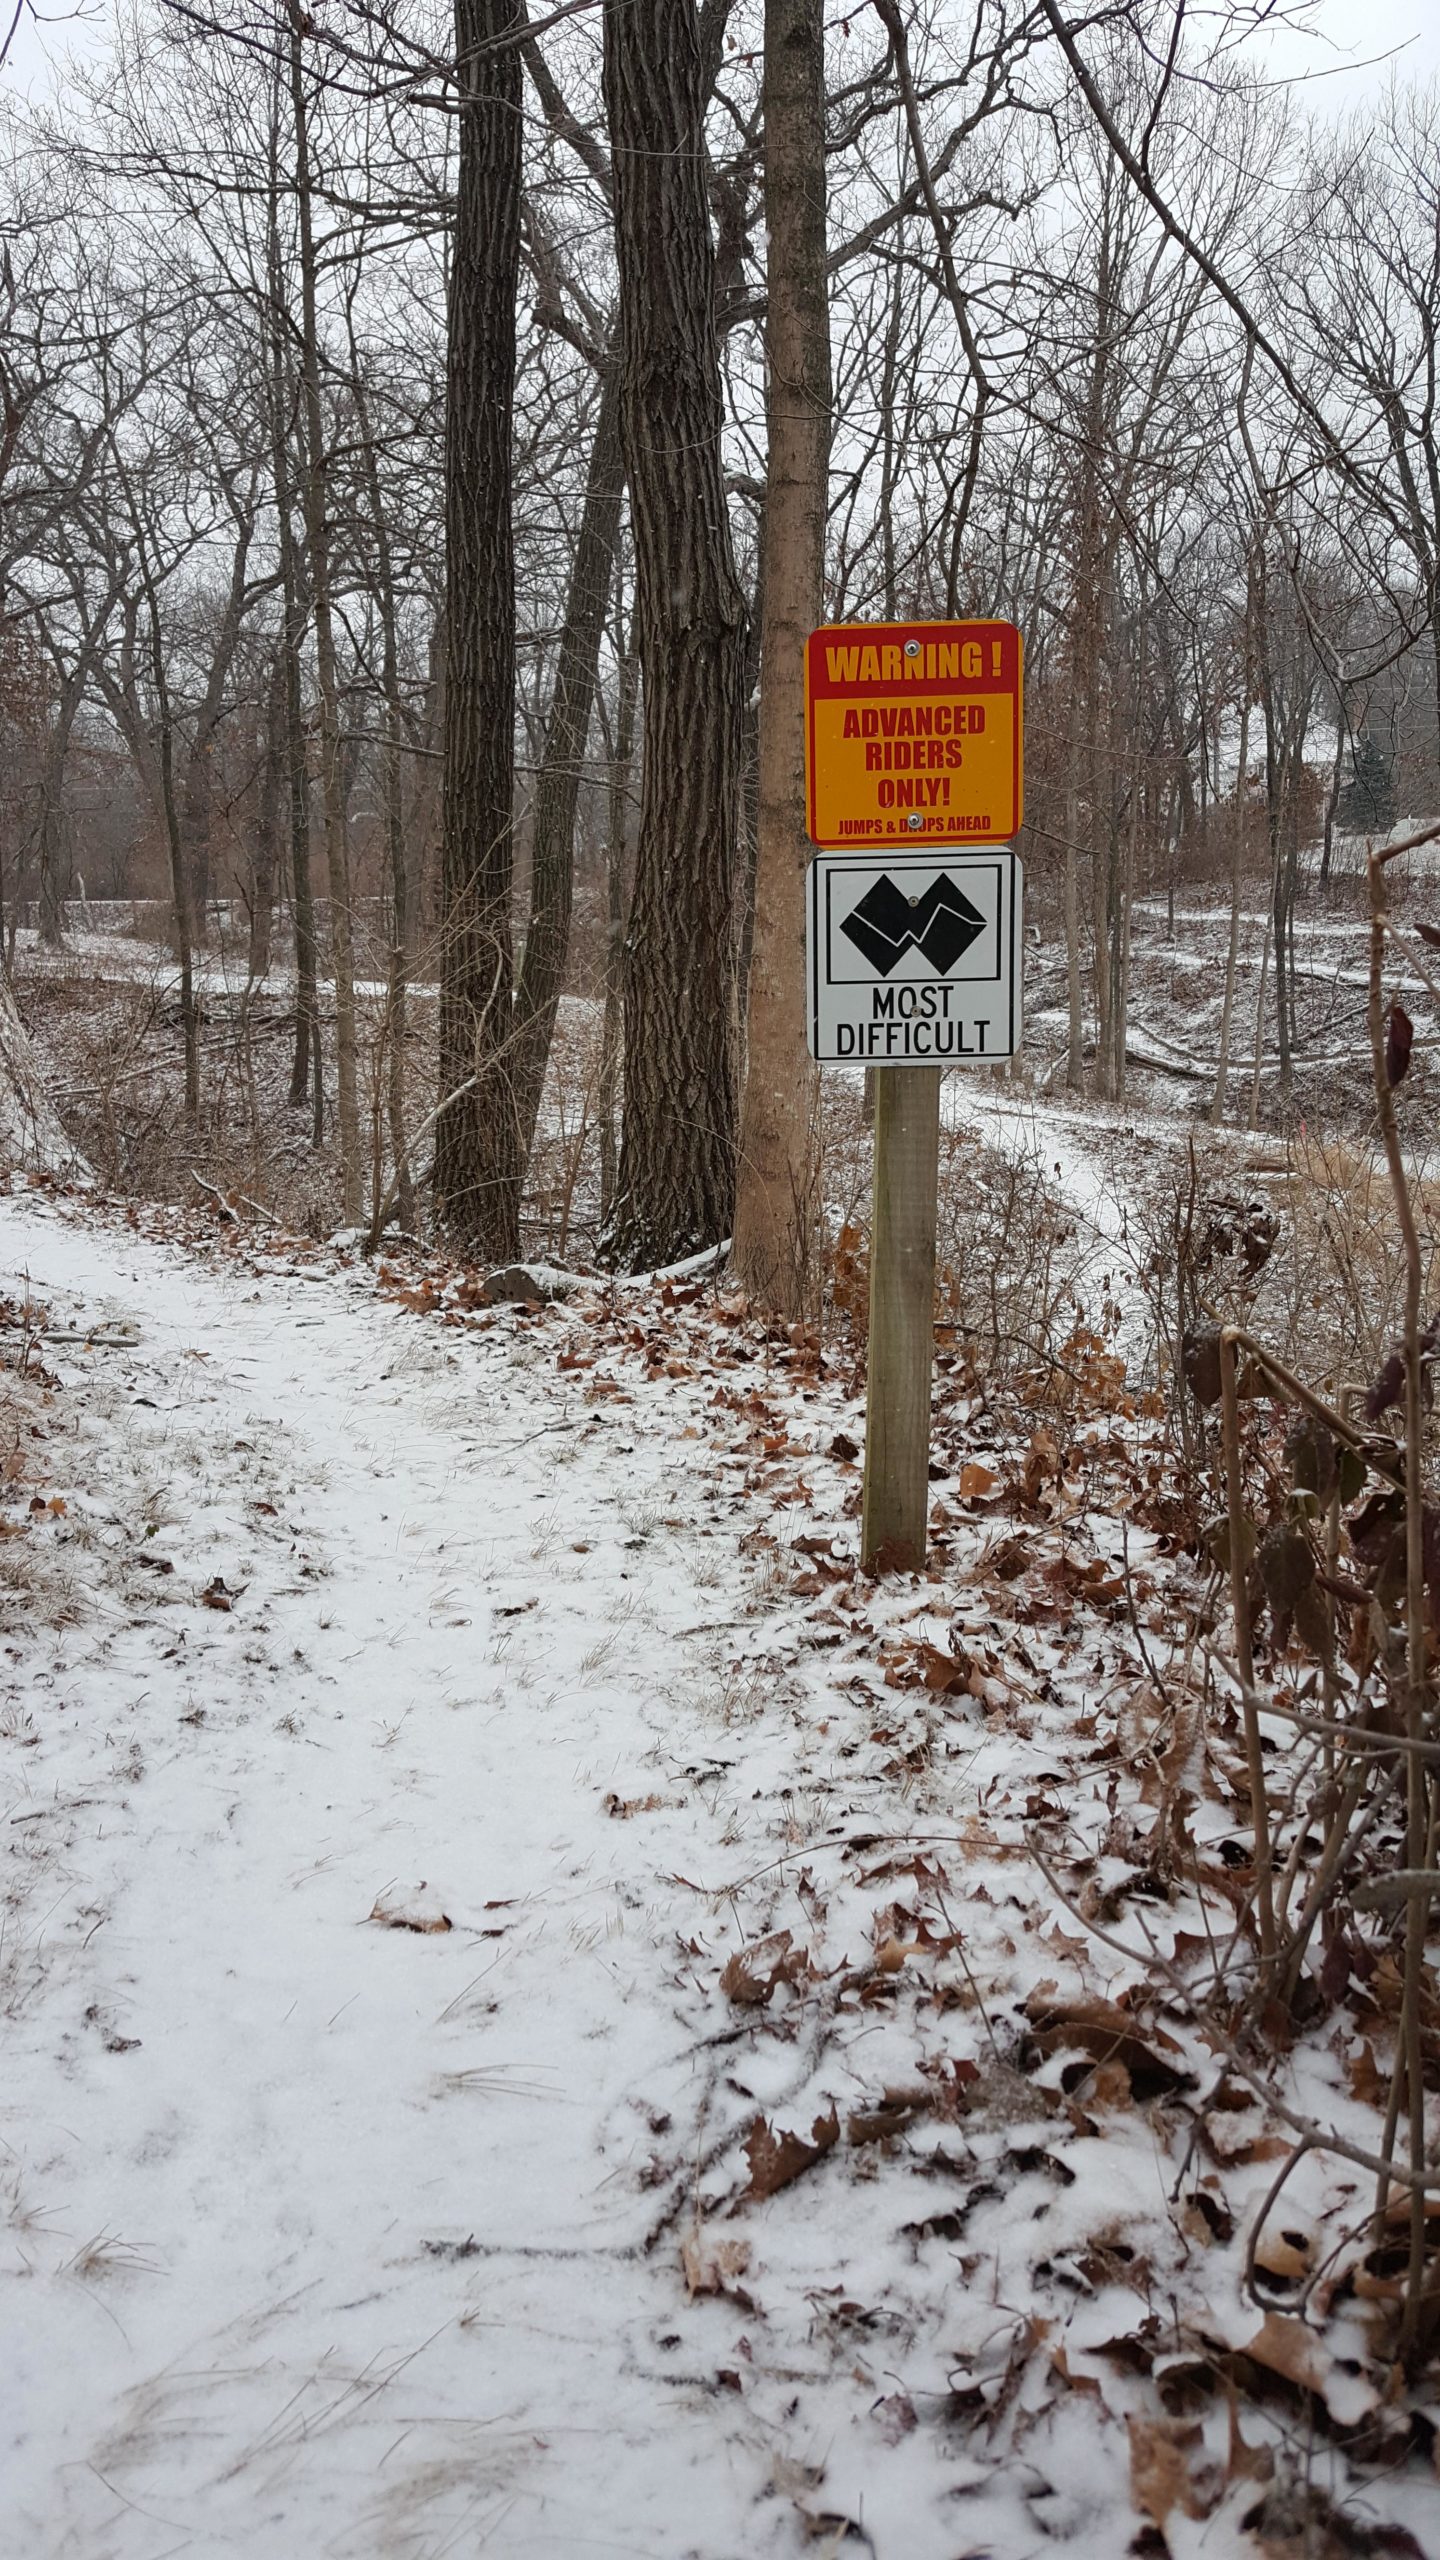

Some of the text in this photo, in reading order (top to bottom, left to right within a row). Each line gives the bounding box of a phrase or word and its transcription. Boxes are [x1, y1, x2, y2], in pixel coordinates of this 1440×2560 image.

[825, 642, 983, 683] WARNING
[843, 705, 986, 739] ADVANCED
[865, 739, 963, 771] RIDERS
[877, 777, 950, 808] ONLY!
[838, 815, 991, 835] JUMPS & DOPS AHEAD
[872, 985, 954, 1019] MOST
[837, 1020, 991, 1056] DIFFICULT
